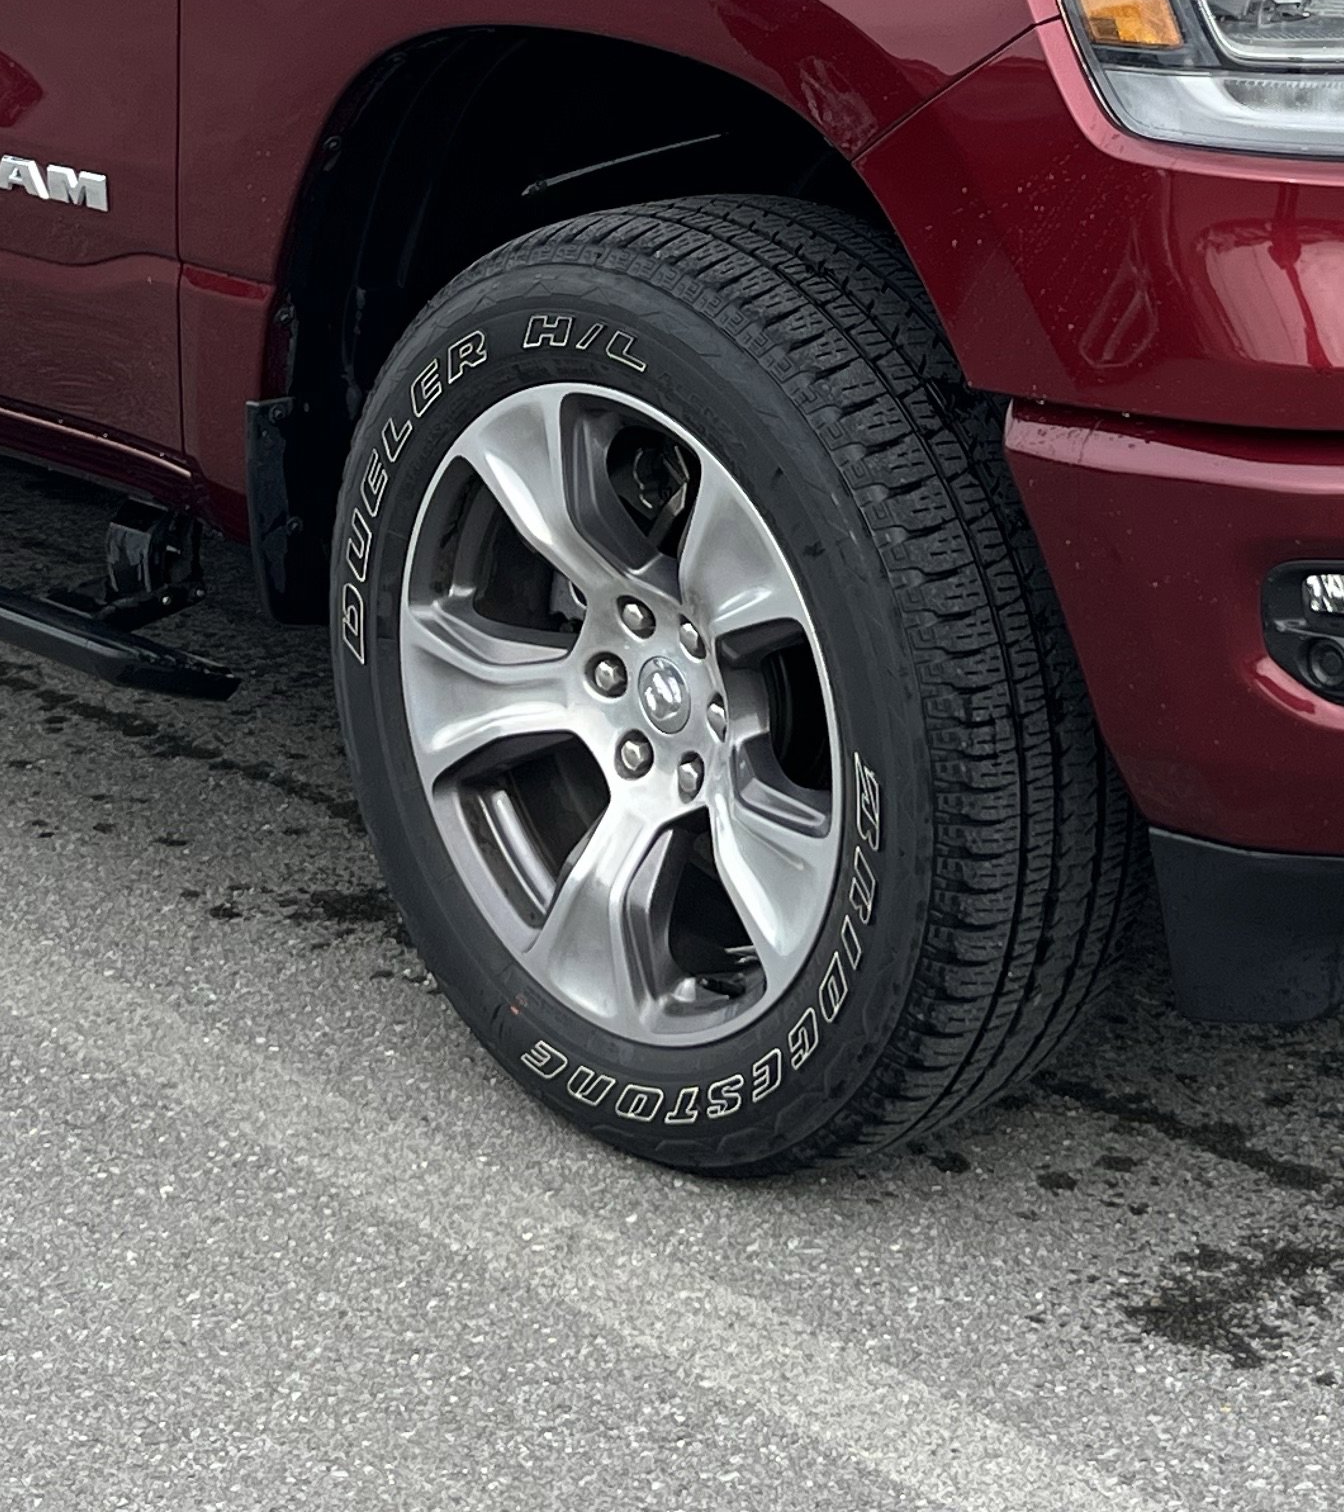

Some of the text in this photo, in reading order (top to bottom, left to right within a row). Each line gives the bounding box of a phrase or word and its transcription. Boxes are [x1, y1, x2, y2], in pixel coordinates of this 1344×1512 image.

[342, 330, 488, 665] DUELER
[522, 314, 647, 373] H/L
[521, 751, 880, 1125] BRIDGESTONE
